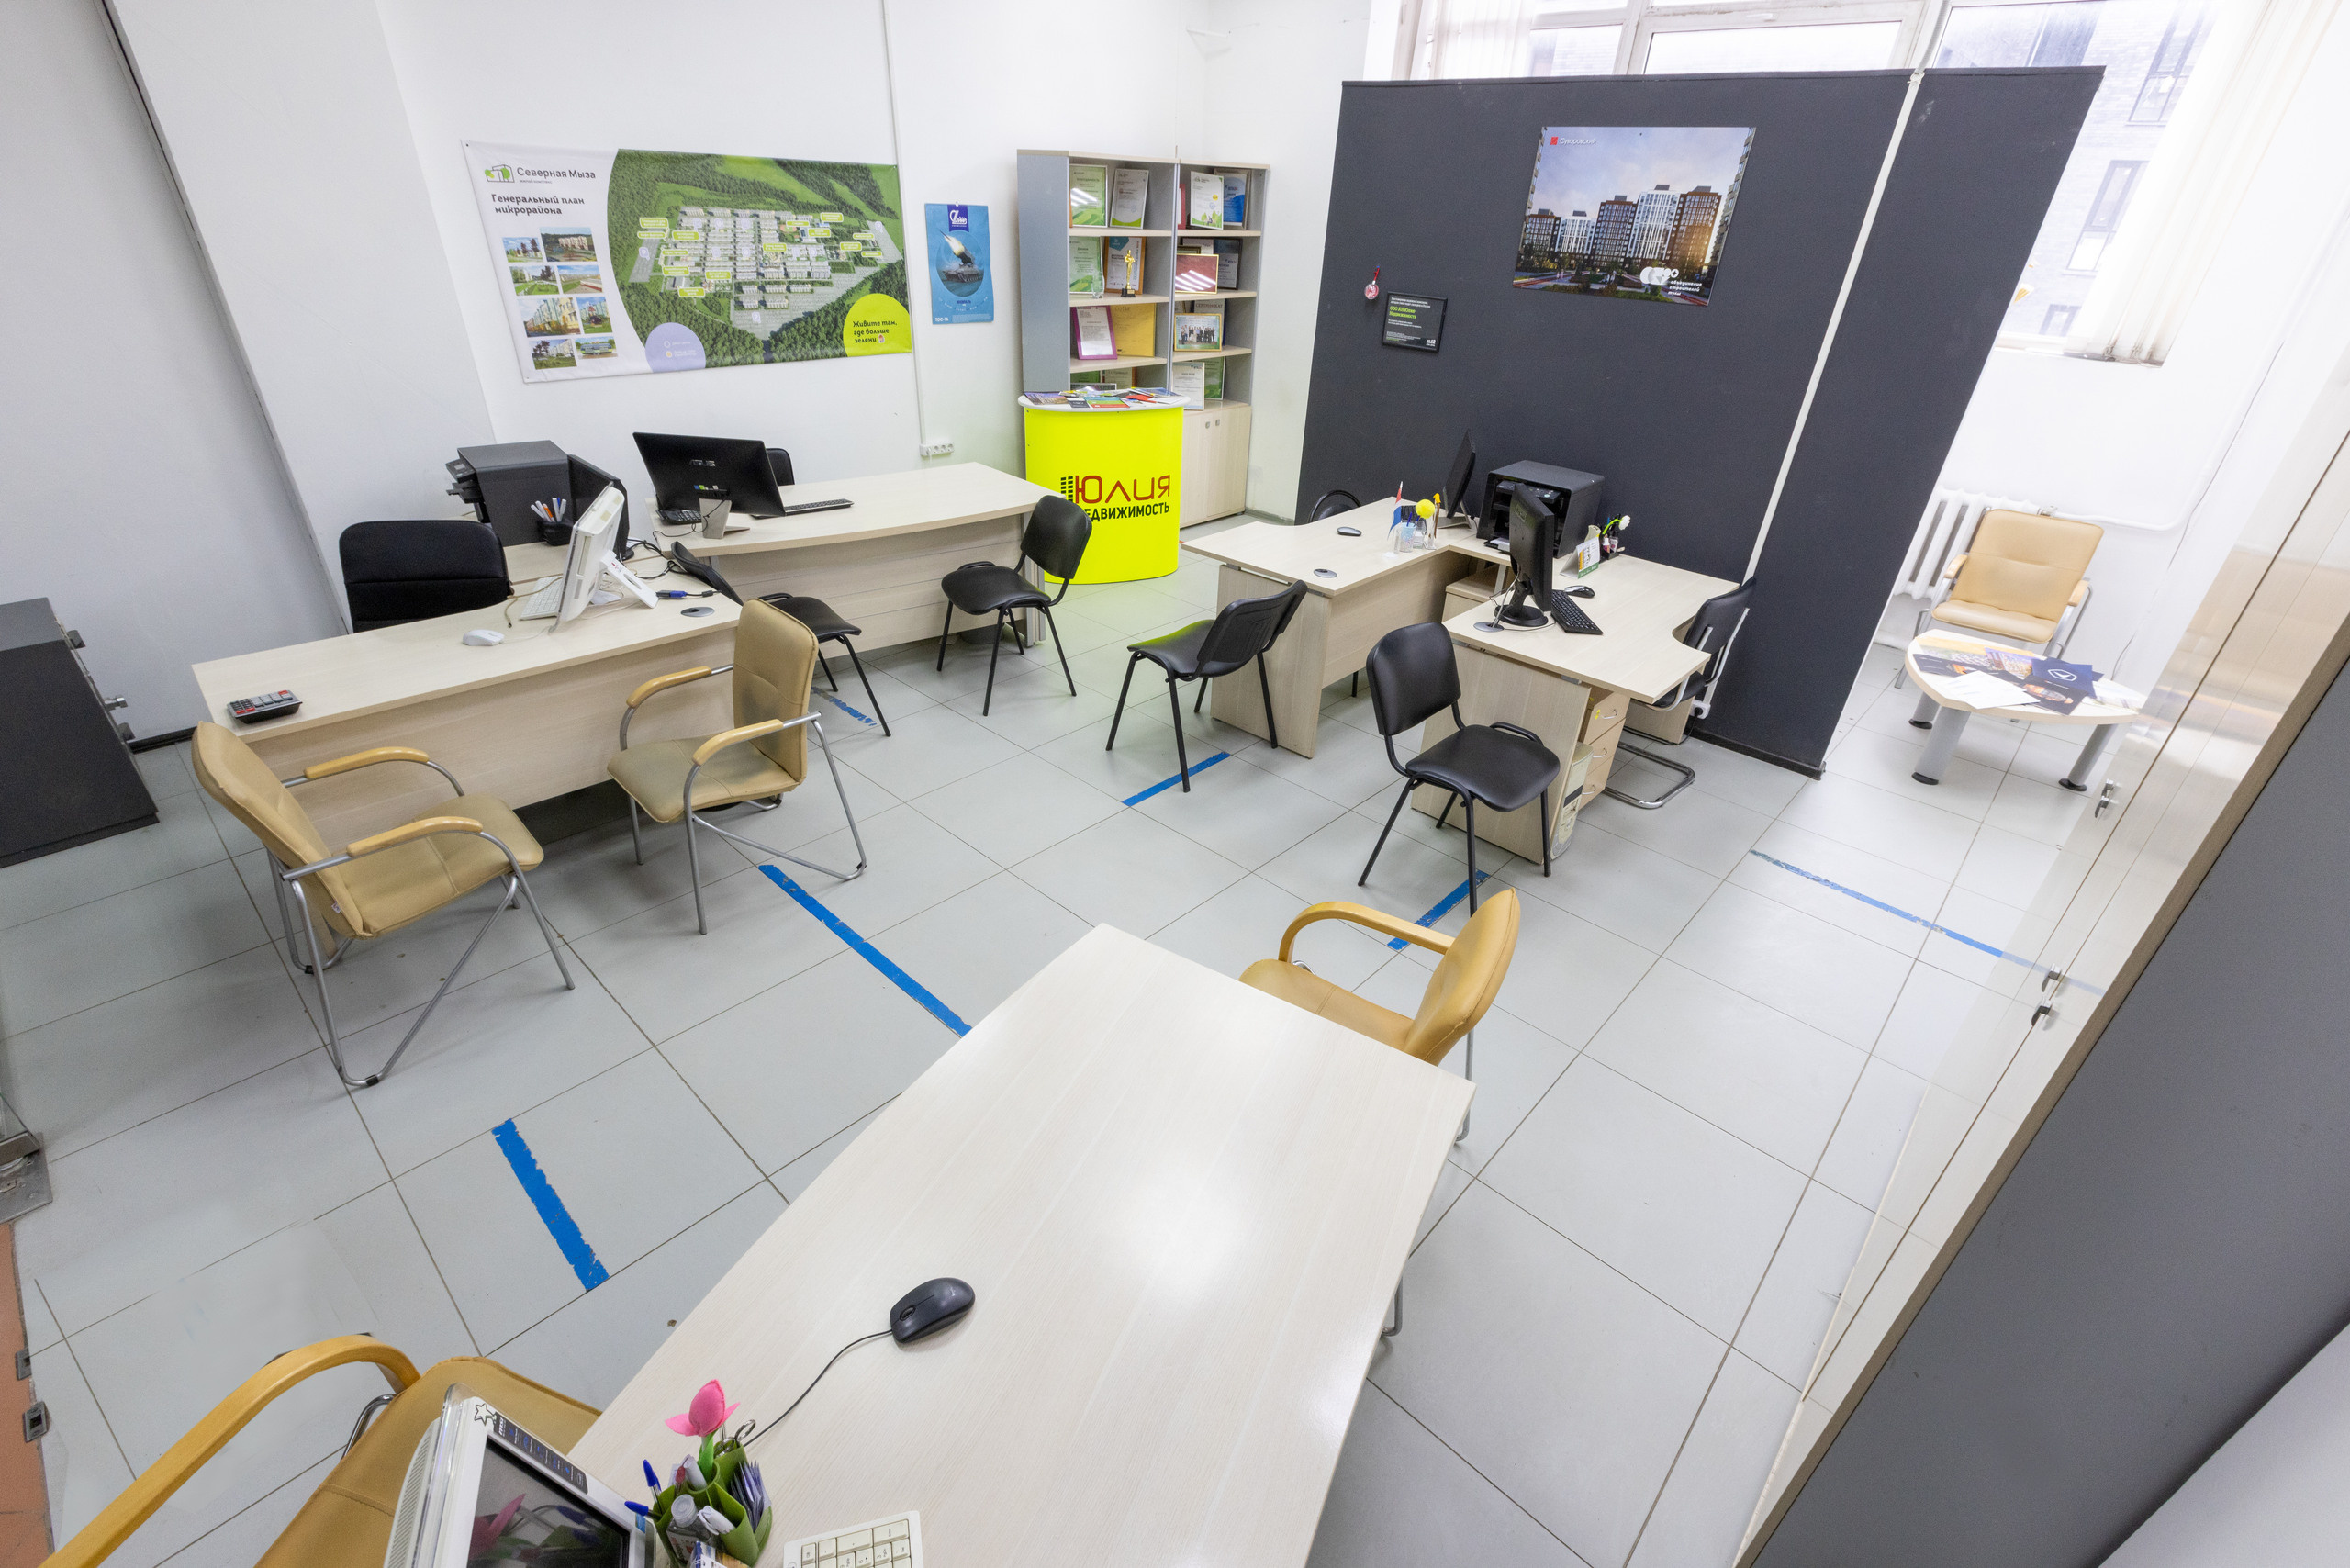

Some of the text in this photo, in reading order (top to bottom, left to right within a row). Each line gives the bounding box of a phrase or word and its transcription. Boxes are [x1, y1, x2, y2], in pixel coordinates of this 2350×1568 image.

[1560, 137, 1597, 145] Суворовский
[517, 167, 596, 179] Северная Мыза
[491, 194, 560, 205] Генеральный
[495, 205, 563, 217] микрорайона
[688, 459, 716, 467] ASUS
